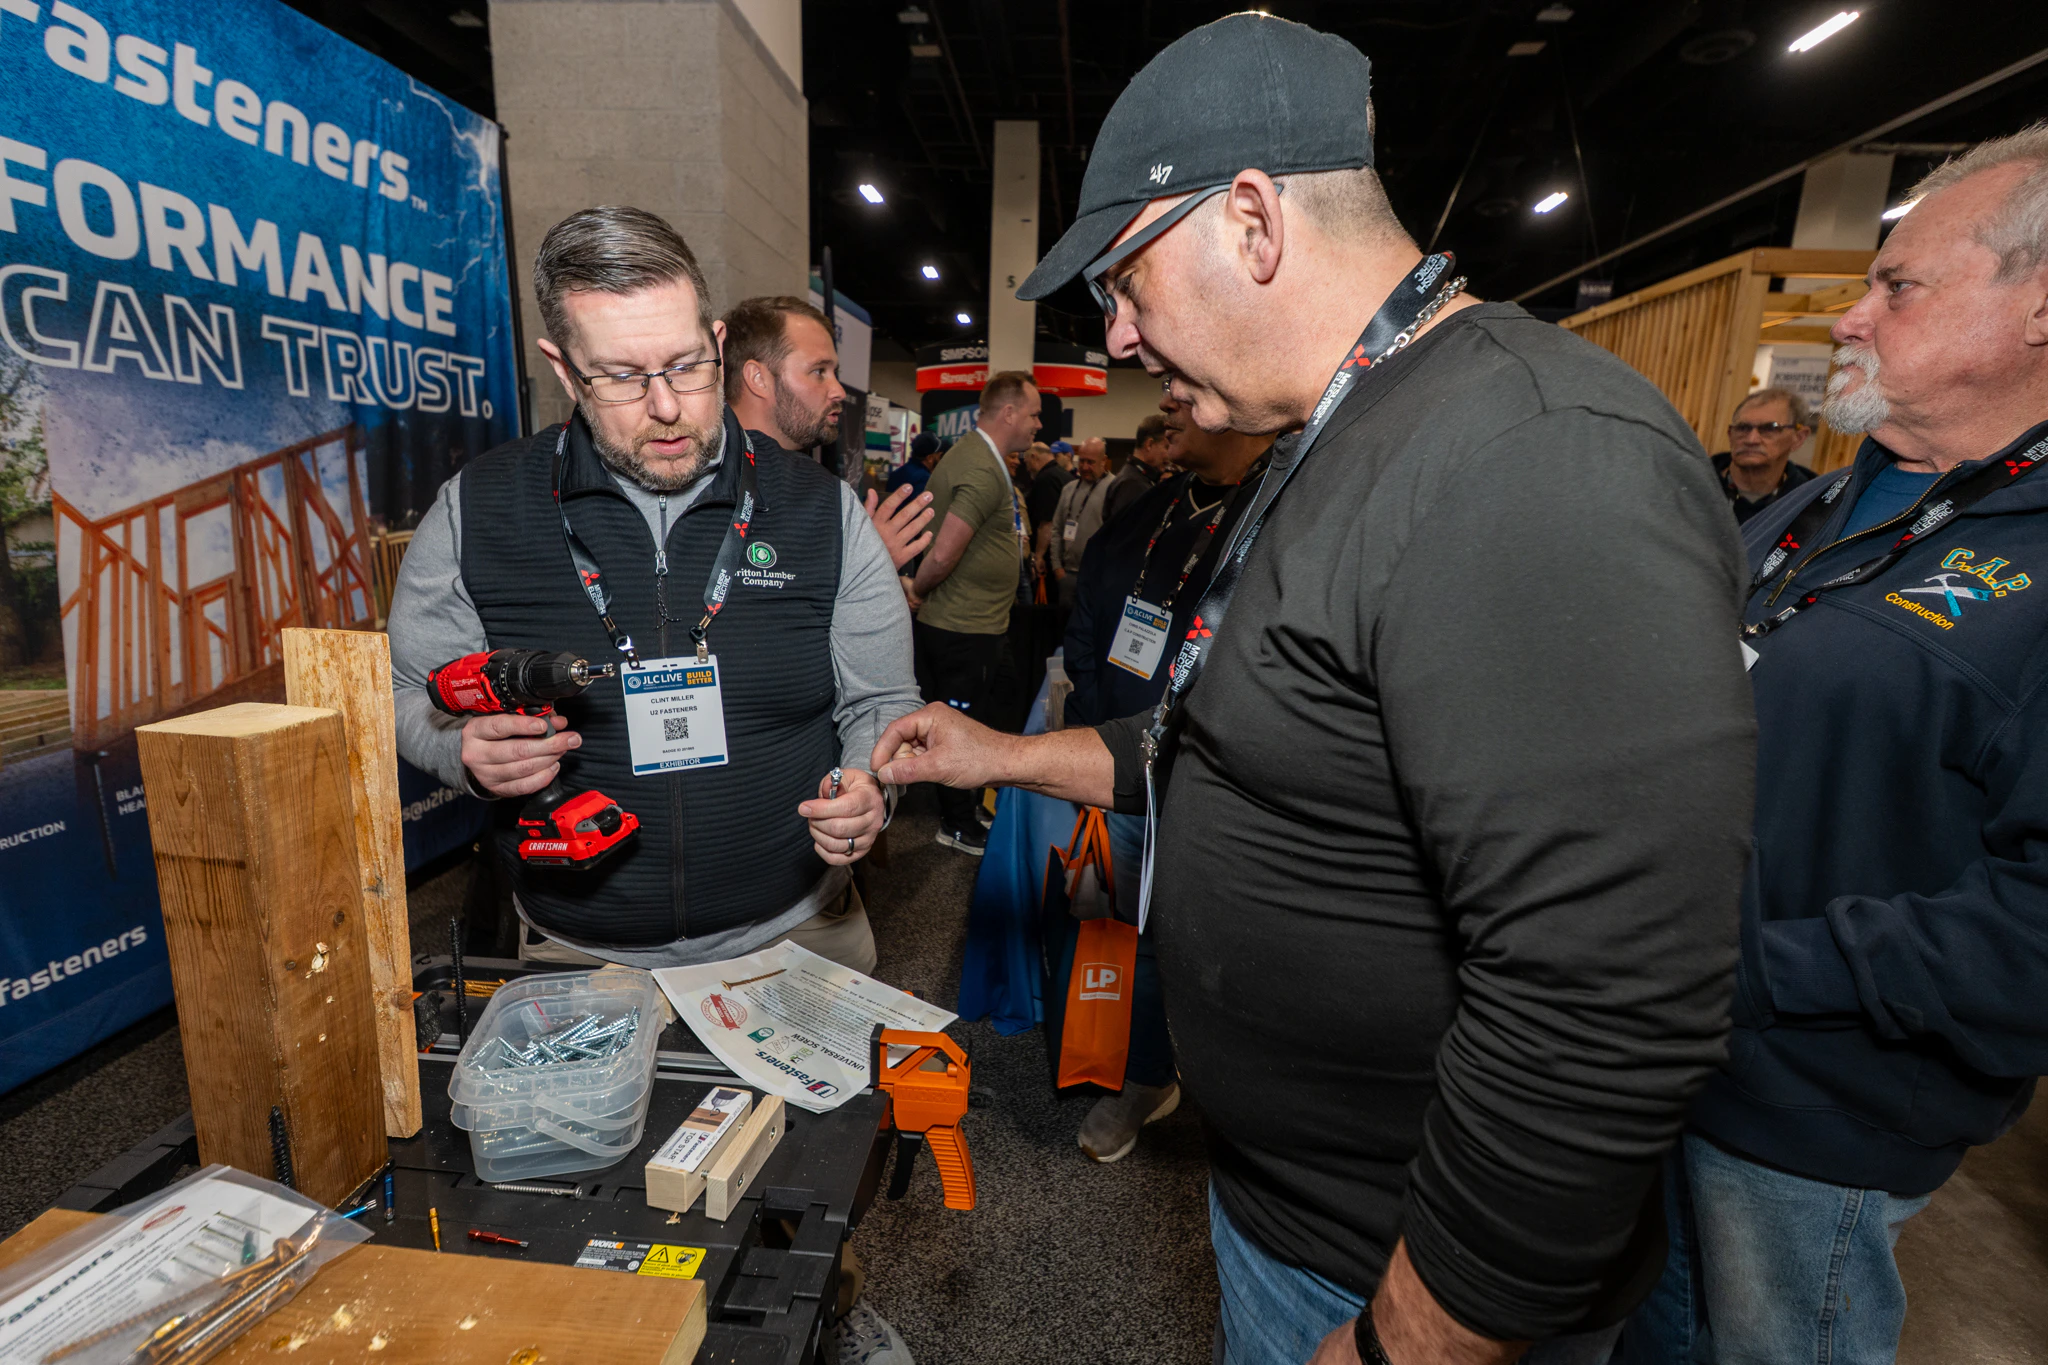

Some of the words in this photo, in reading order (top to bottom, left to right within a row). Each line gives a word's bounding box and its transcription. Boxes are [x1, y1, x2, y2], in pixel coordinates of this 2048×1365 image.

[0, 136, 457, 338] FORMANCE
[1415, 255, 1448, 295] MITSUBISHI
[0, 264, 245, 390] CAN
[261, 316, 493, 420] TRUST.
[1909, 499, 1954, 532] MITSUBISHI
[1913, 507, 1954, 535] ELECTRIC
[735, 568, 762, 578] ritton
[763, 569, 796, 581] Lumber
[742, 576, 785, 589] Company
[1885, 592, 1955, 631] Construction
[686, 670, 712, 679] BUILD
[1171, 644, 1201, 692] MITSUBISHI
[643, 675, 660, 685] JLC
[661, 673, 682, 683] LIVE
[687, 677, 713, 685] BETTER
[660, 706, 698, 714] FASTENERS
[660, 758, 700, 769] EXHIBITOR
[118, 798, 146, 816] HEA
[529, 842, 568, 851] CRAFTSMAN
[1086, 969, 1117, 988] LP
[791, 1033, 819, 1049] SCREW
[755, 1051, 816, 1086] Fasteners
[820, 1047, 865, 1072] UNIVERSAL
[682, 1130, 696, 1144] TOP
[679, 1138, 702, 1164] Fasteners
